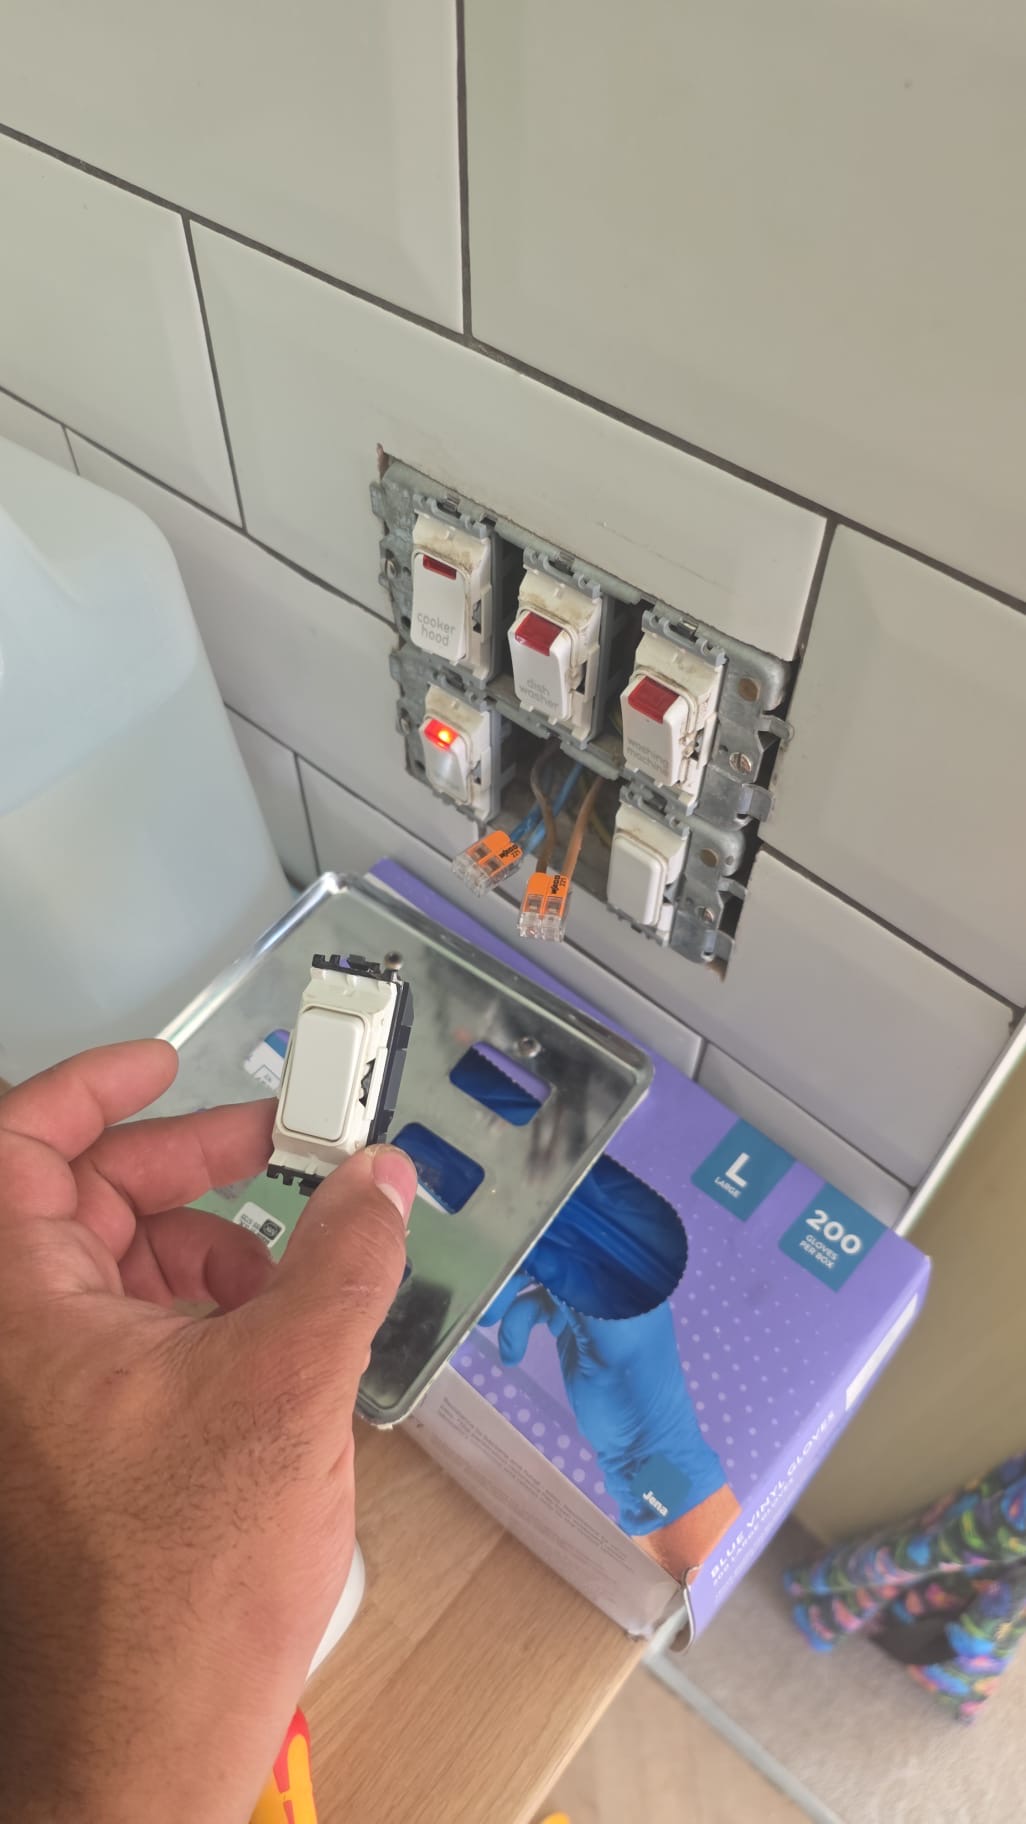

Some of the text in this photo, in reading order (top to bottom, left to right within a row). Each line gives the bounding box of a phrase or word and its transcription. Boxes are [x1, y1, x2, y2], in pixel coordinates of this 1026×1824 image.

[417, 613, 456, 634] cooker
[421, 623, 449, 647] hood
[526, 679, 551, 697] dish
[725, 1152, 750, 1188] L
[714, 1176, 741, 1198] LARGE
[805, 1209, 862, 1254] 200
[799, 1240, 834, 1268] PER BOX
[805, 1234, 838, 1260] GLOVES
[642, 1490, 669, 1516] Jena
[711, 1531, 744, 1578] BLUE
[746, 1480, 786, 1528] VINYL
[787, 1410, 835, 1476] GLOVES
